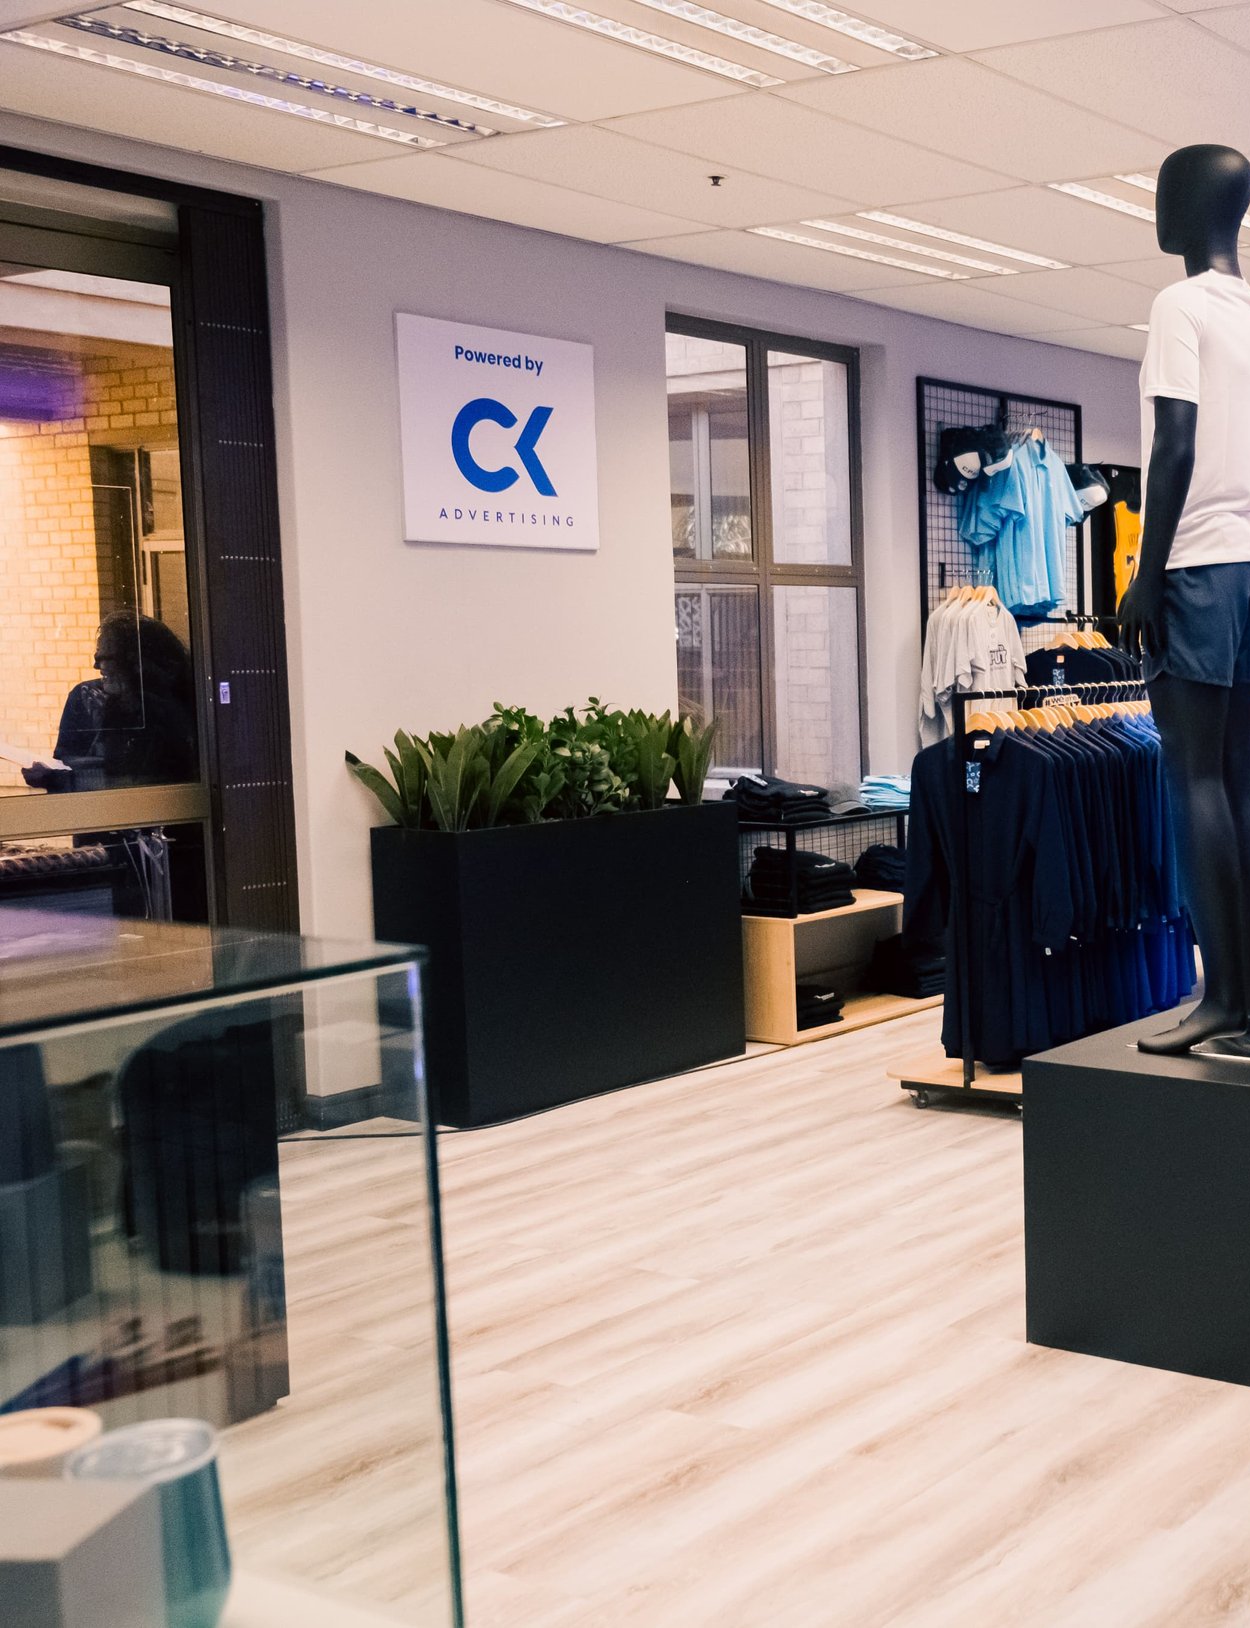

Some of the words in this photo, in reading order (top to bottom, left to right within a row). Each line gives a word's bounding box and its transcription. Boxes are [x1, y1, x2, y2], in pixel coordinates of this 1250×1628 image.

[455, 345, 521, 369] Powered
[525, 356, 543, 376] by
[451, 398, 558, 497] CK
[439, 508, 574, 527] ADVERTISING
